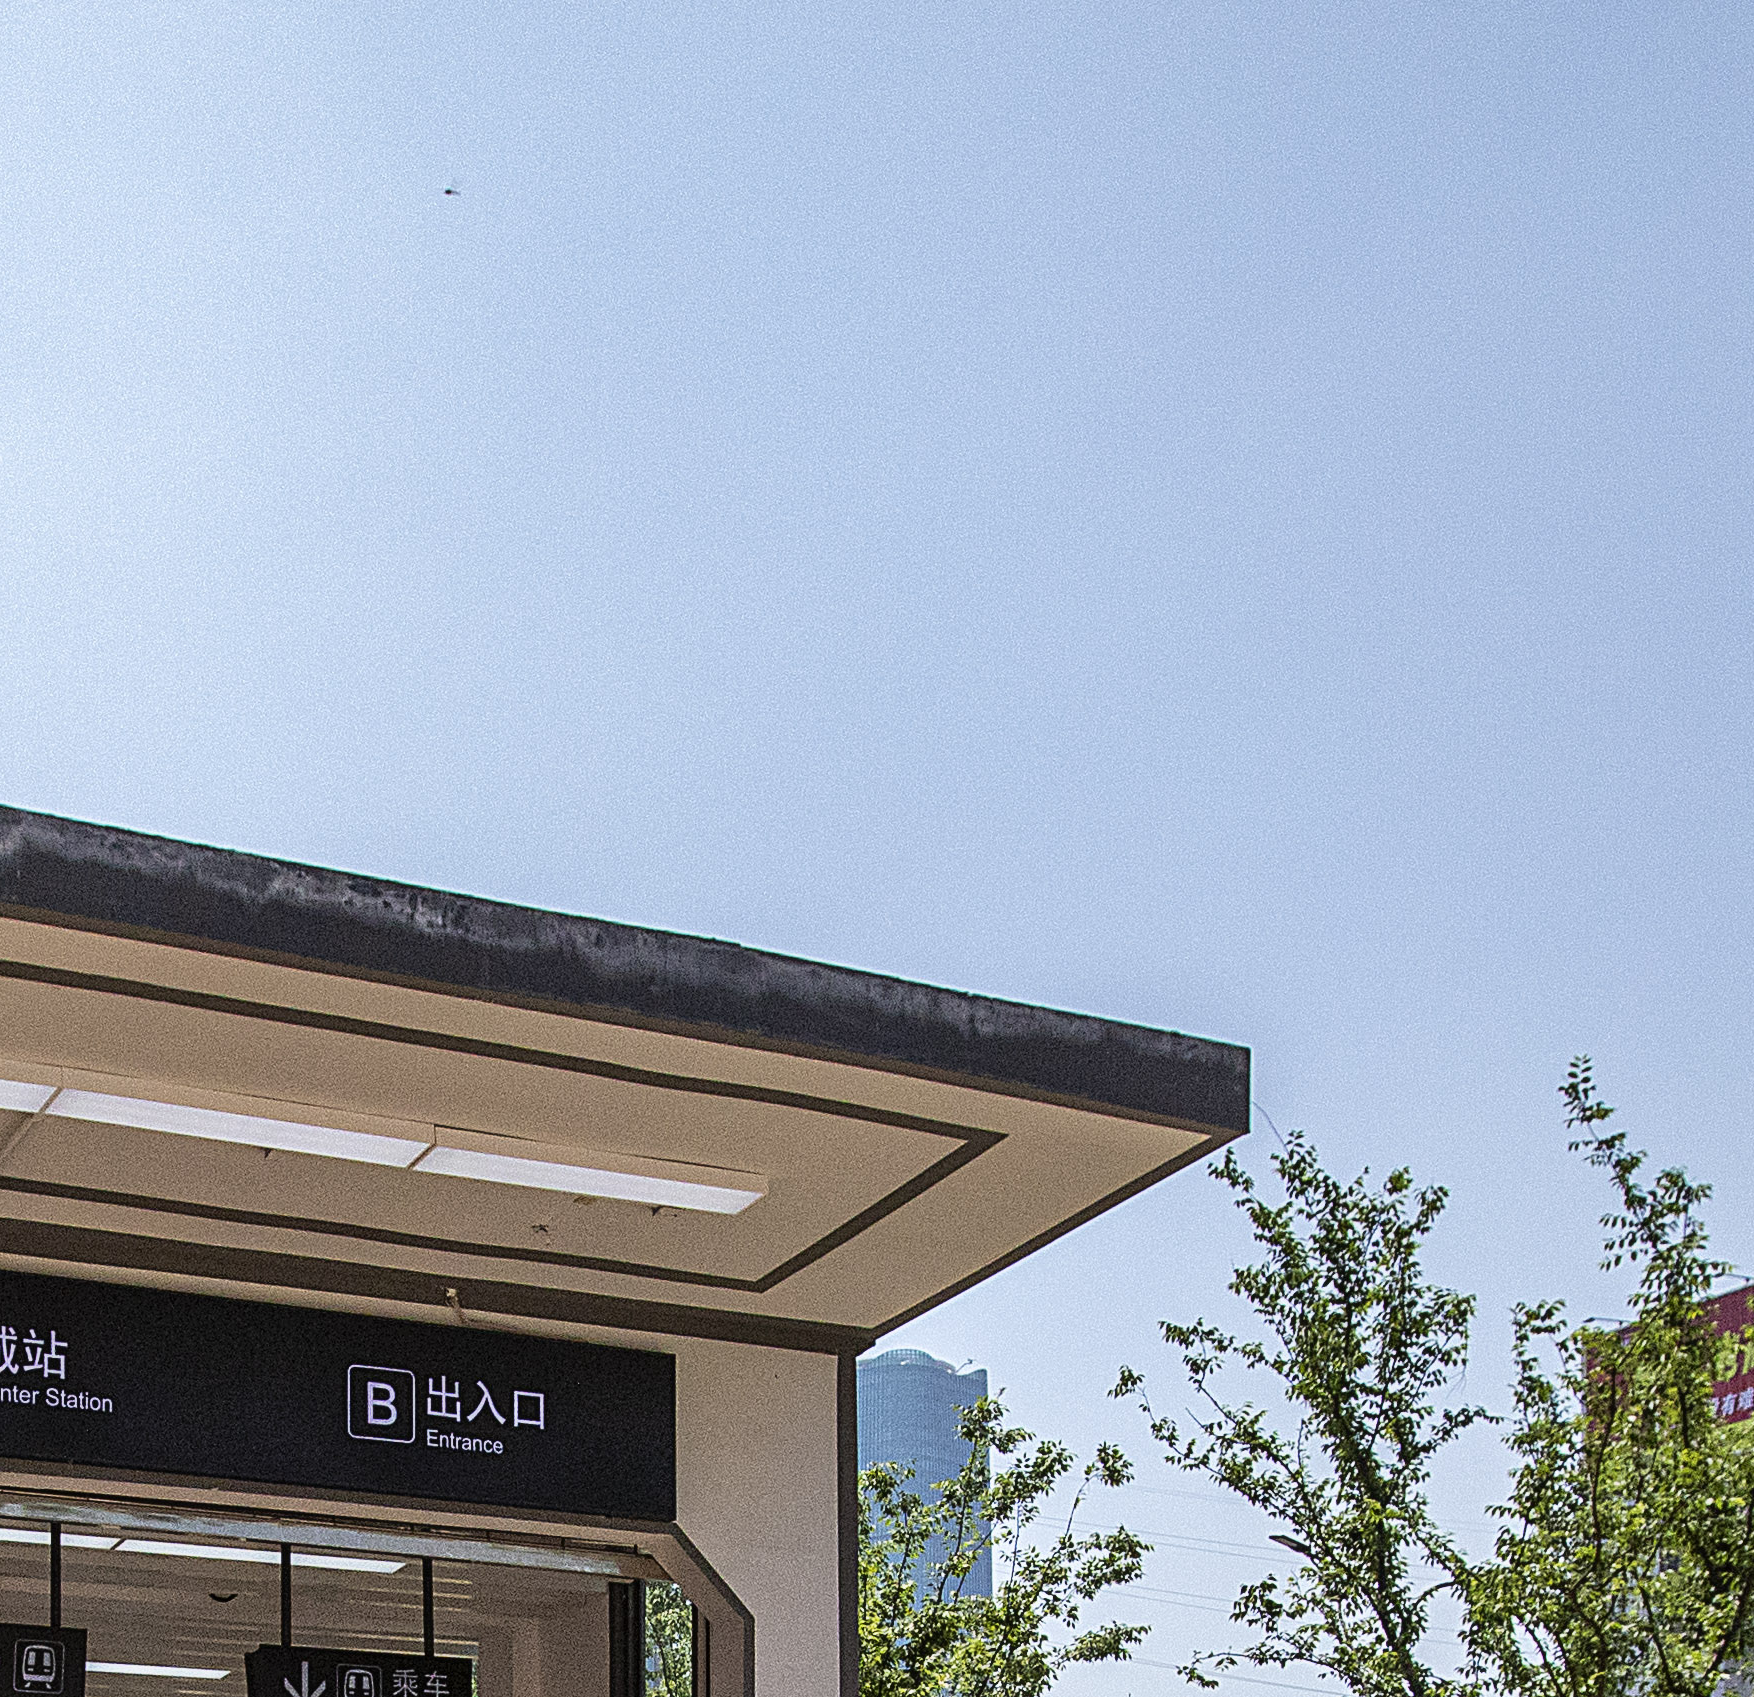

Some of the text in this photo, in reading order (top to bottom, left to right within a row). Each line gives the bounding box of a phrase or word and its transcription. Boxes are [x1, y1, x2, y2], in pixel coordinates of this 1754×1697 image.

[44, 1387, 114, 1414] Station
[365, 1381, 397, 1426] B
[425, 1374, 547, 1431] 出入口
[426, 1430, 505, 1455] Entrance
